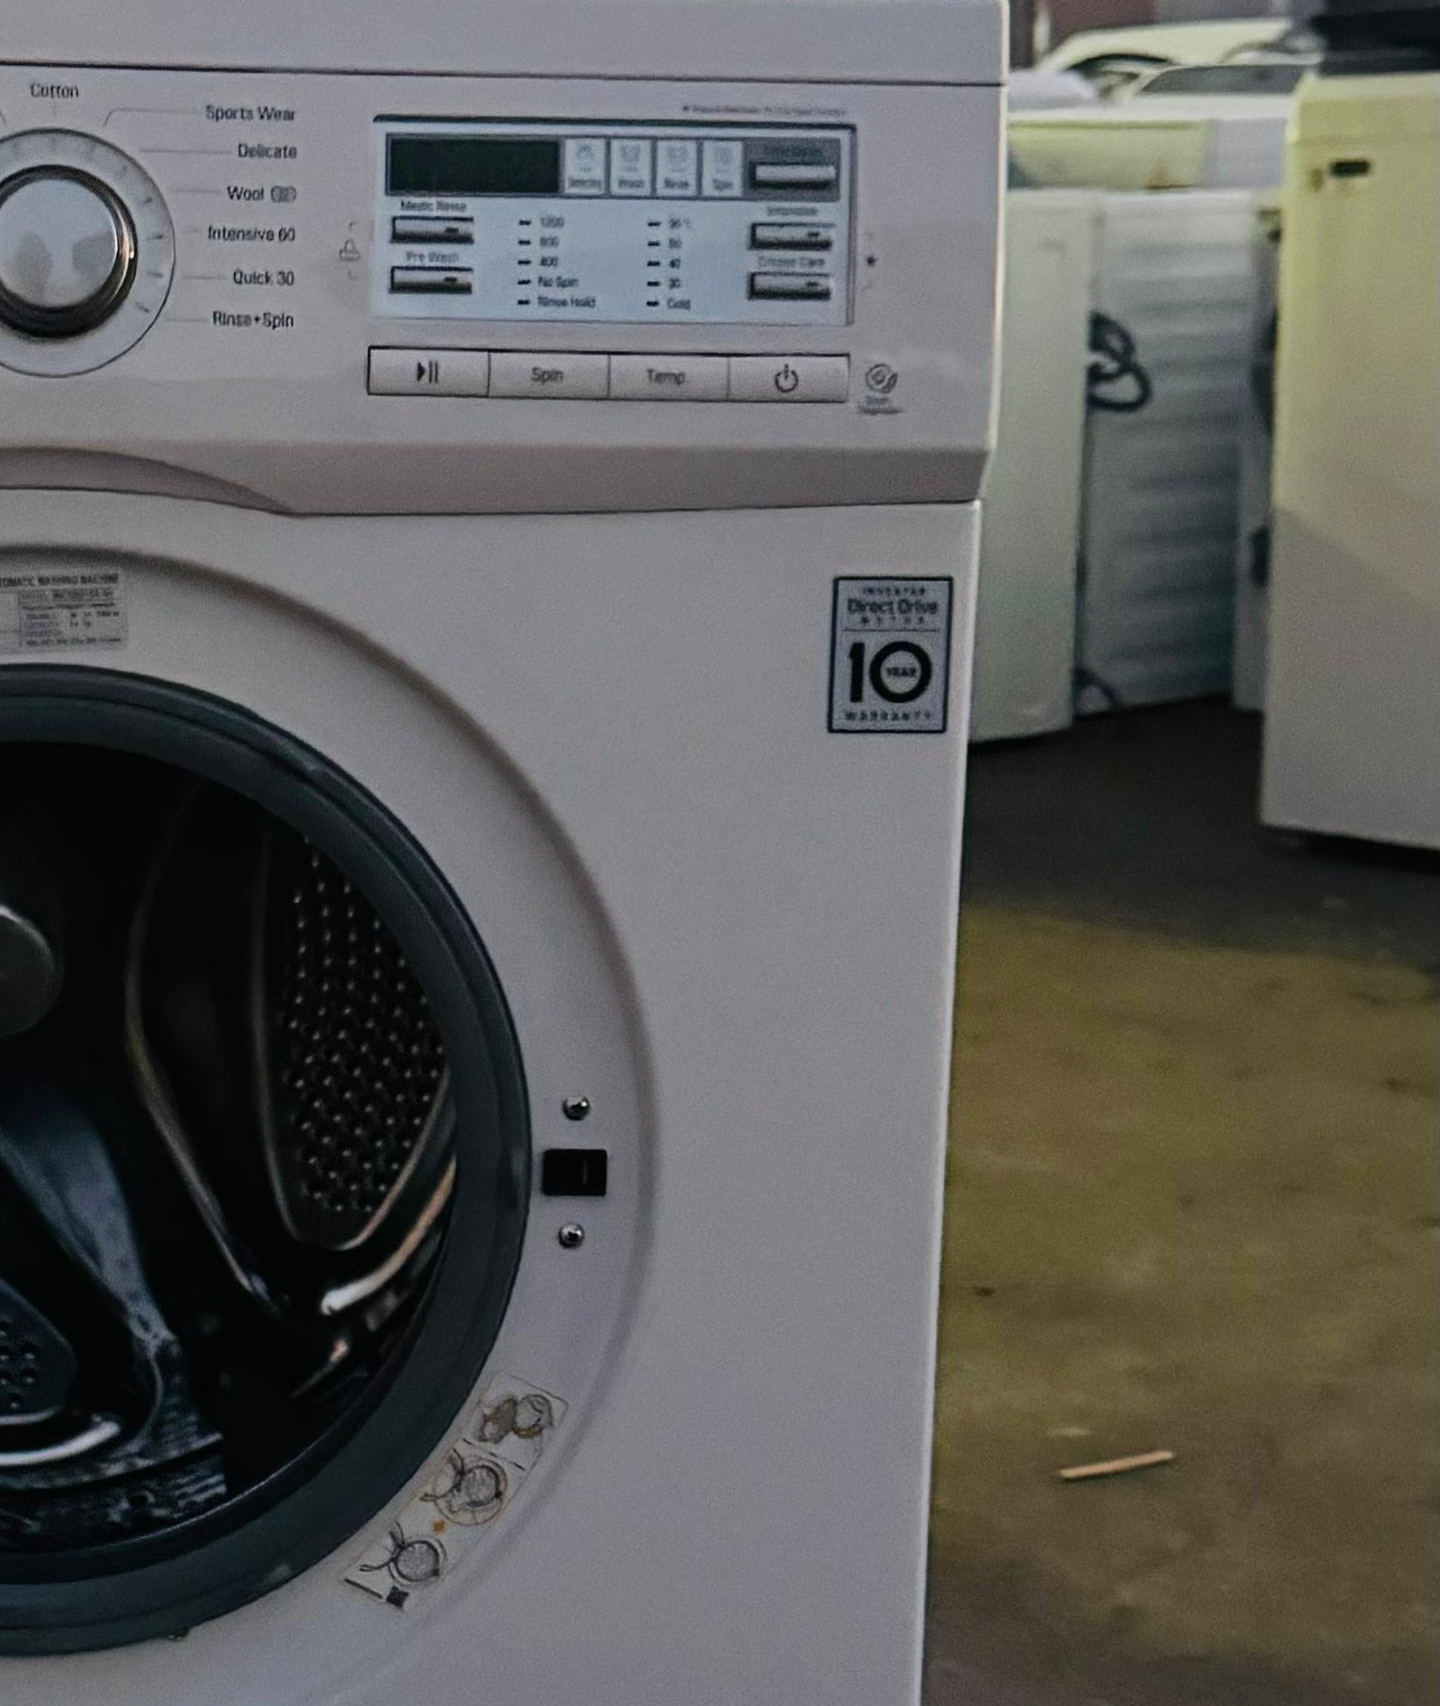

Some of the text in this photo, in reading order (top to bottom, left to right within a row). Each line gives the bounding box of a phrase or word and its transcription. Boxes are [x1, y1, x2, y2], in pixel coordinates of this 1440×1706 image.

[30, 83, 80, 99] Cotton
[206, 105, 296, 124] Sports Wear
[238, 144, 298, 159] Delicate
[227, 186, 265, 201] Wool
[208, 226, 275, 242] Intensive
[233, 269, 295, 286] Quick 30
[212, 311, 295, 329] Rinse+Spin
[531, 365, 564, 385] Spin
[646, 367, 686, 387] Temp
[847, 598, 895, 615] Direct
[849, 641, 933, 704] 10
